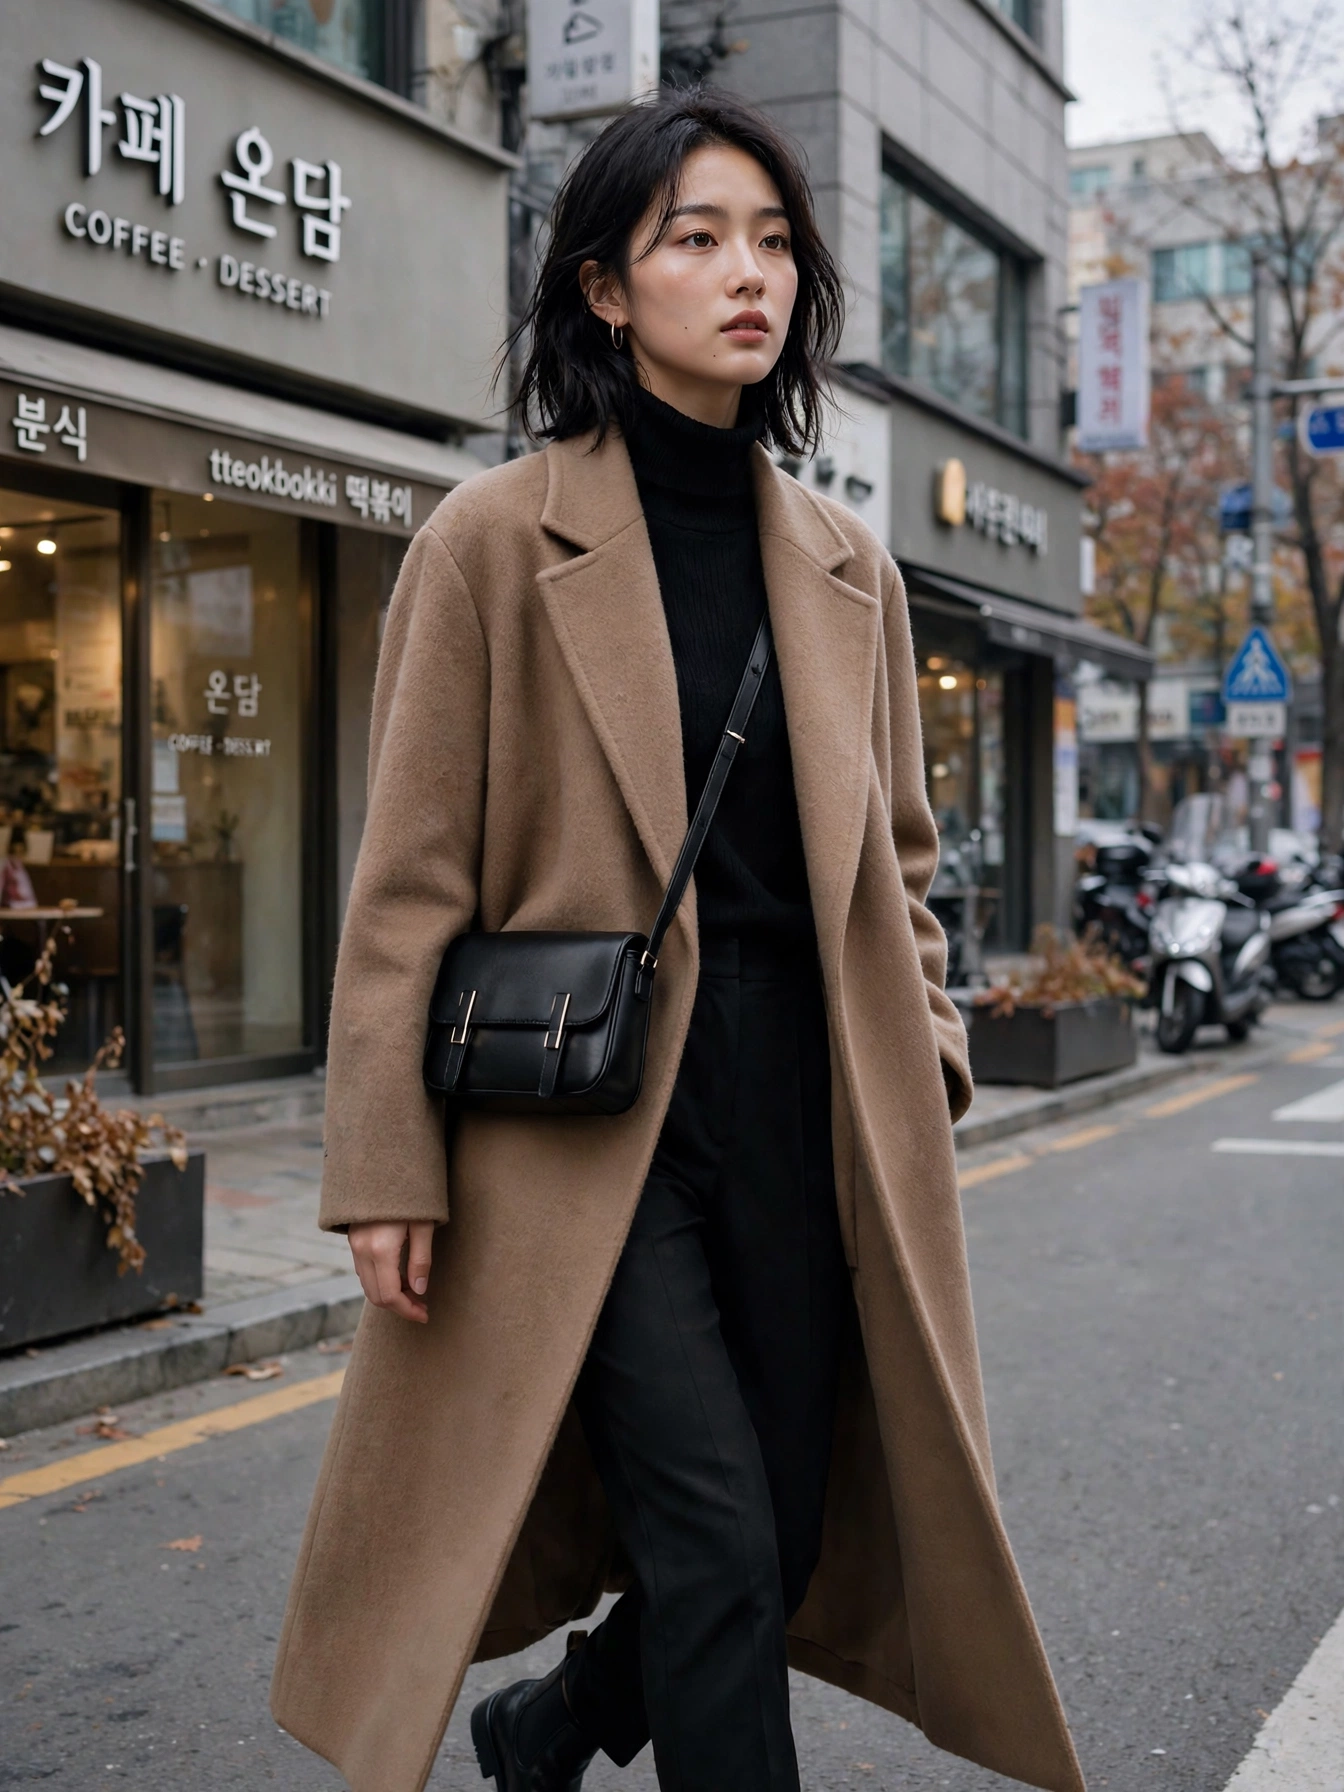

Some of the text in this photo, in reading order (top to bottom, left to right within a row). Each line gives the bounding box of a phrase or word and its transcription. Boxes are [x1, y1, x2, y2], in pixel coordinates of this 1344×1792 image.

[37, 57, 352, 263] 카페 온담
[64, 202, 186, 271] COFFEE
[219, 253, 332, 317] DESSERT
[13, 393, 88, 462] 분식
[208, 448, 338, 508] tteokbokki
[204, 669, 262, 718] 온담
